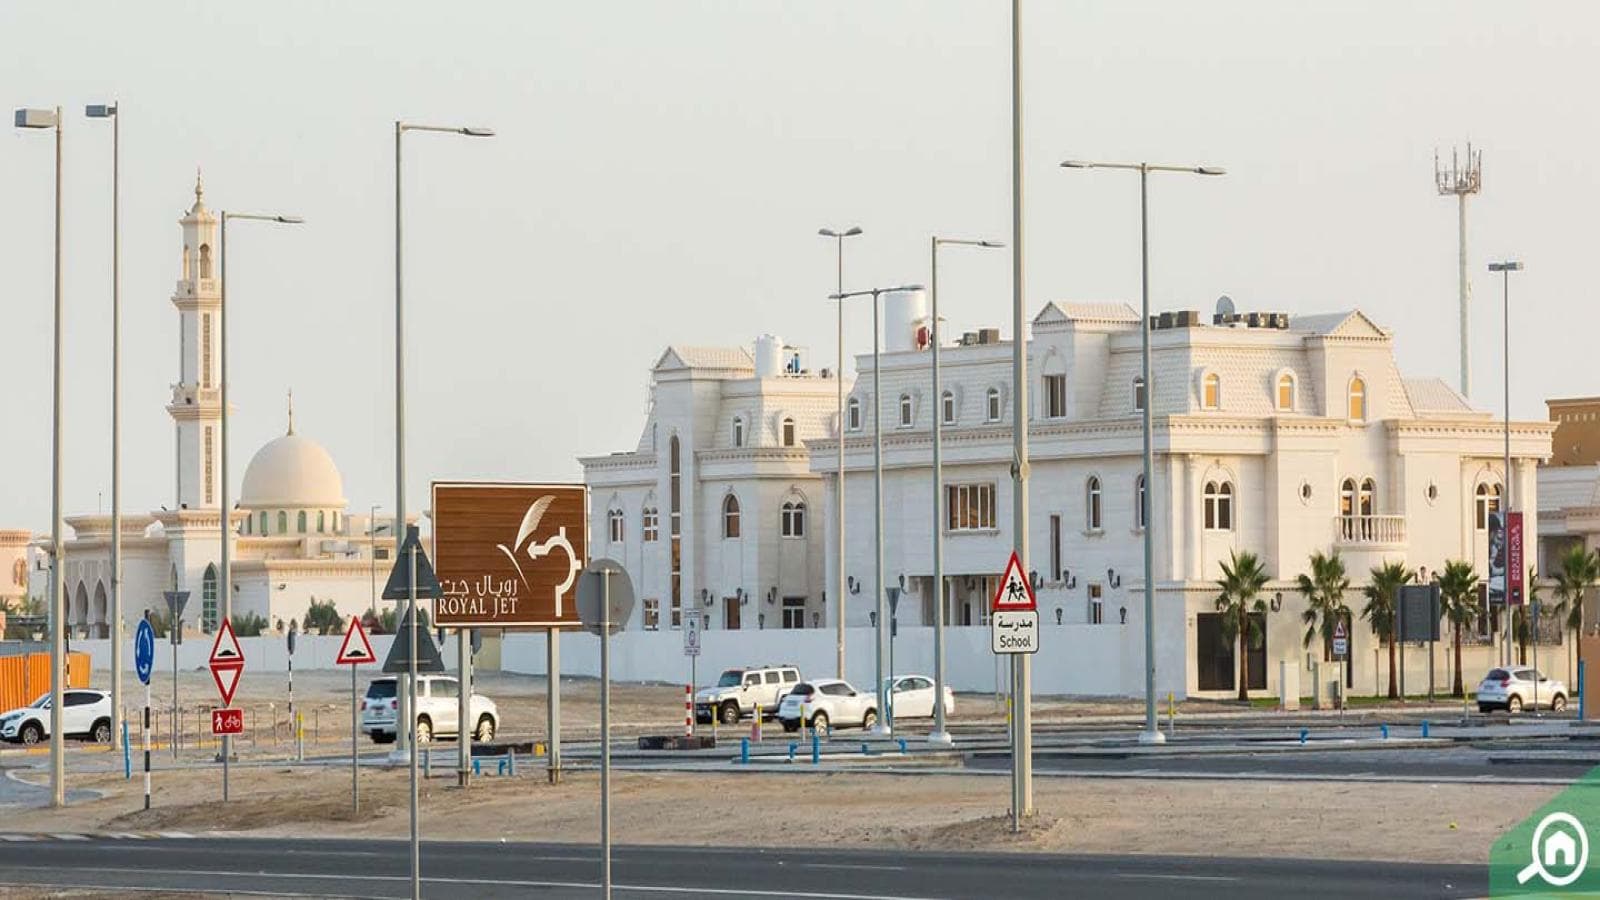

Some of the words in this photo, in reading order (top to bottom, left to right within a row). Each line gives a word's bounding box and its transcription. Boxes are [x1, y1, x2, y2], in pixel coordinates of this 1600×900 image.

[439, 579, 470, 598] جت
[476, 575, 517, 597] رويال
[439, 598, 487, 615] ROYAL
[492, 598, 518, 618] JET
[998, 615, 1033, 632] مدرسة
[999, 635, 1031, 648] School
